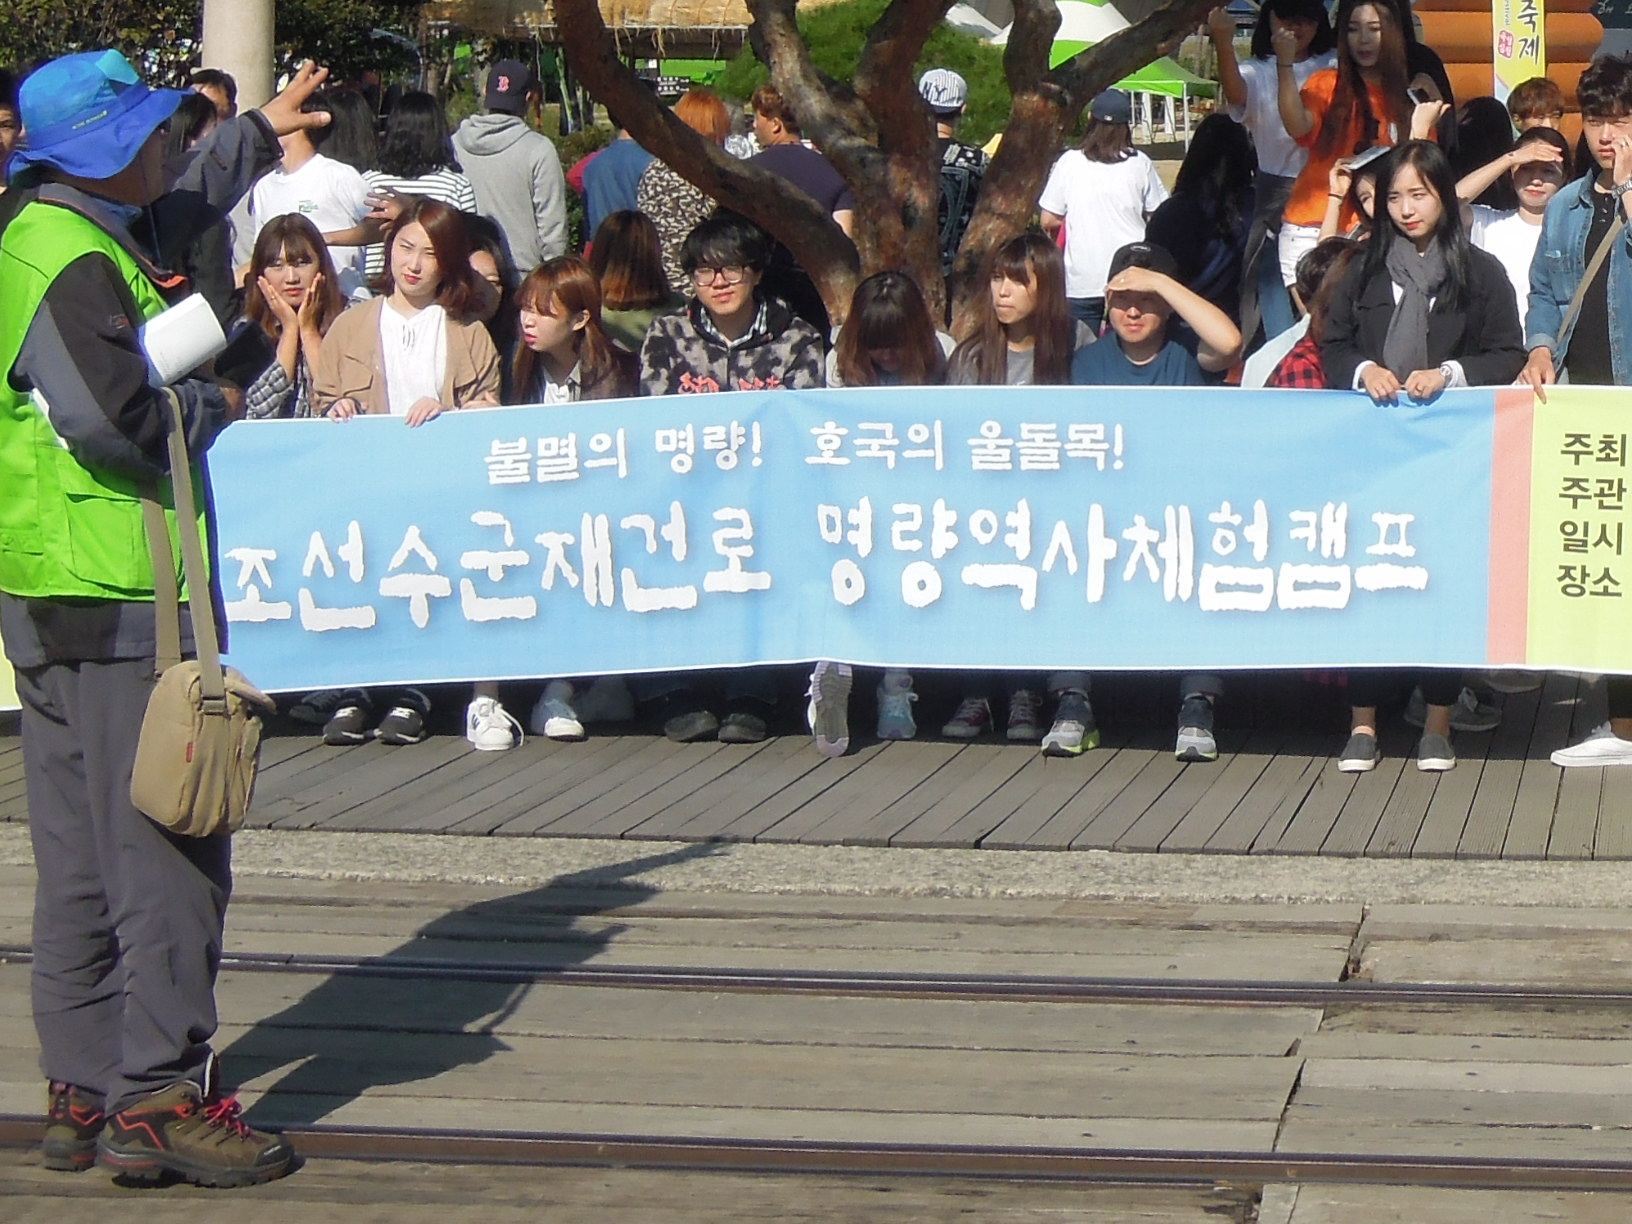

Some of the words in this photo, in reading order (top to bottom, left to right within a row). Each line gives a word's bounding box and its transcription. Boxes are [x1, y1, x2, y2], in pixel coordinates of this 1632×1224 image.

[482, 428, 629, 485] 불멸의
[654, 420, 763, 474] 명량!
[804, 420, 945, 471] 호국의
[966, 419, 1125, 471] 울돌목!
[1561, 433, 1627, 467] 주최
[1559, 478, 1627, 511] 주관
[1559, 520, 1623, 556] 일시
[224, 500, 772, 632] 조선수군재건로
[816, 495, 1432, 613] 명량역사체험캠프
[1558, 564, 1622, 598] 장소
